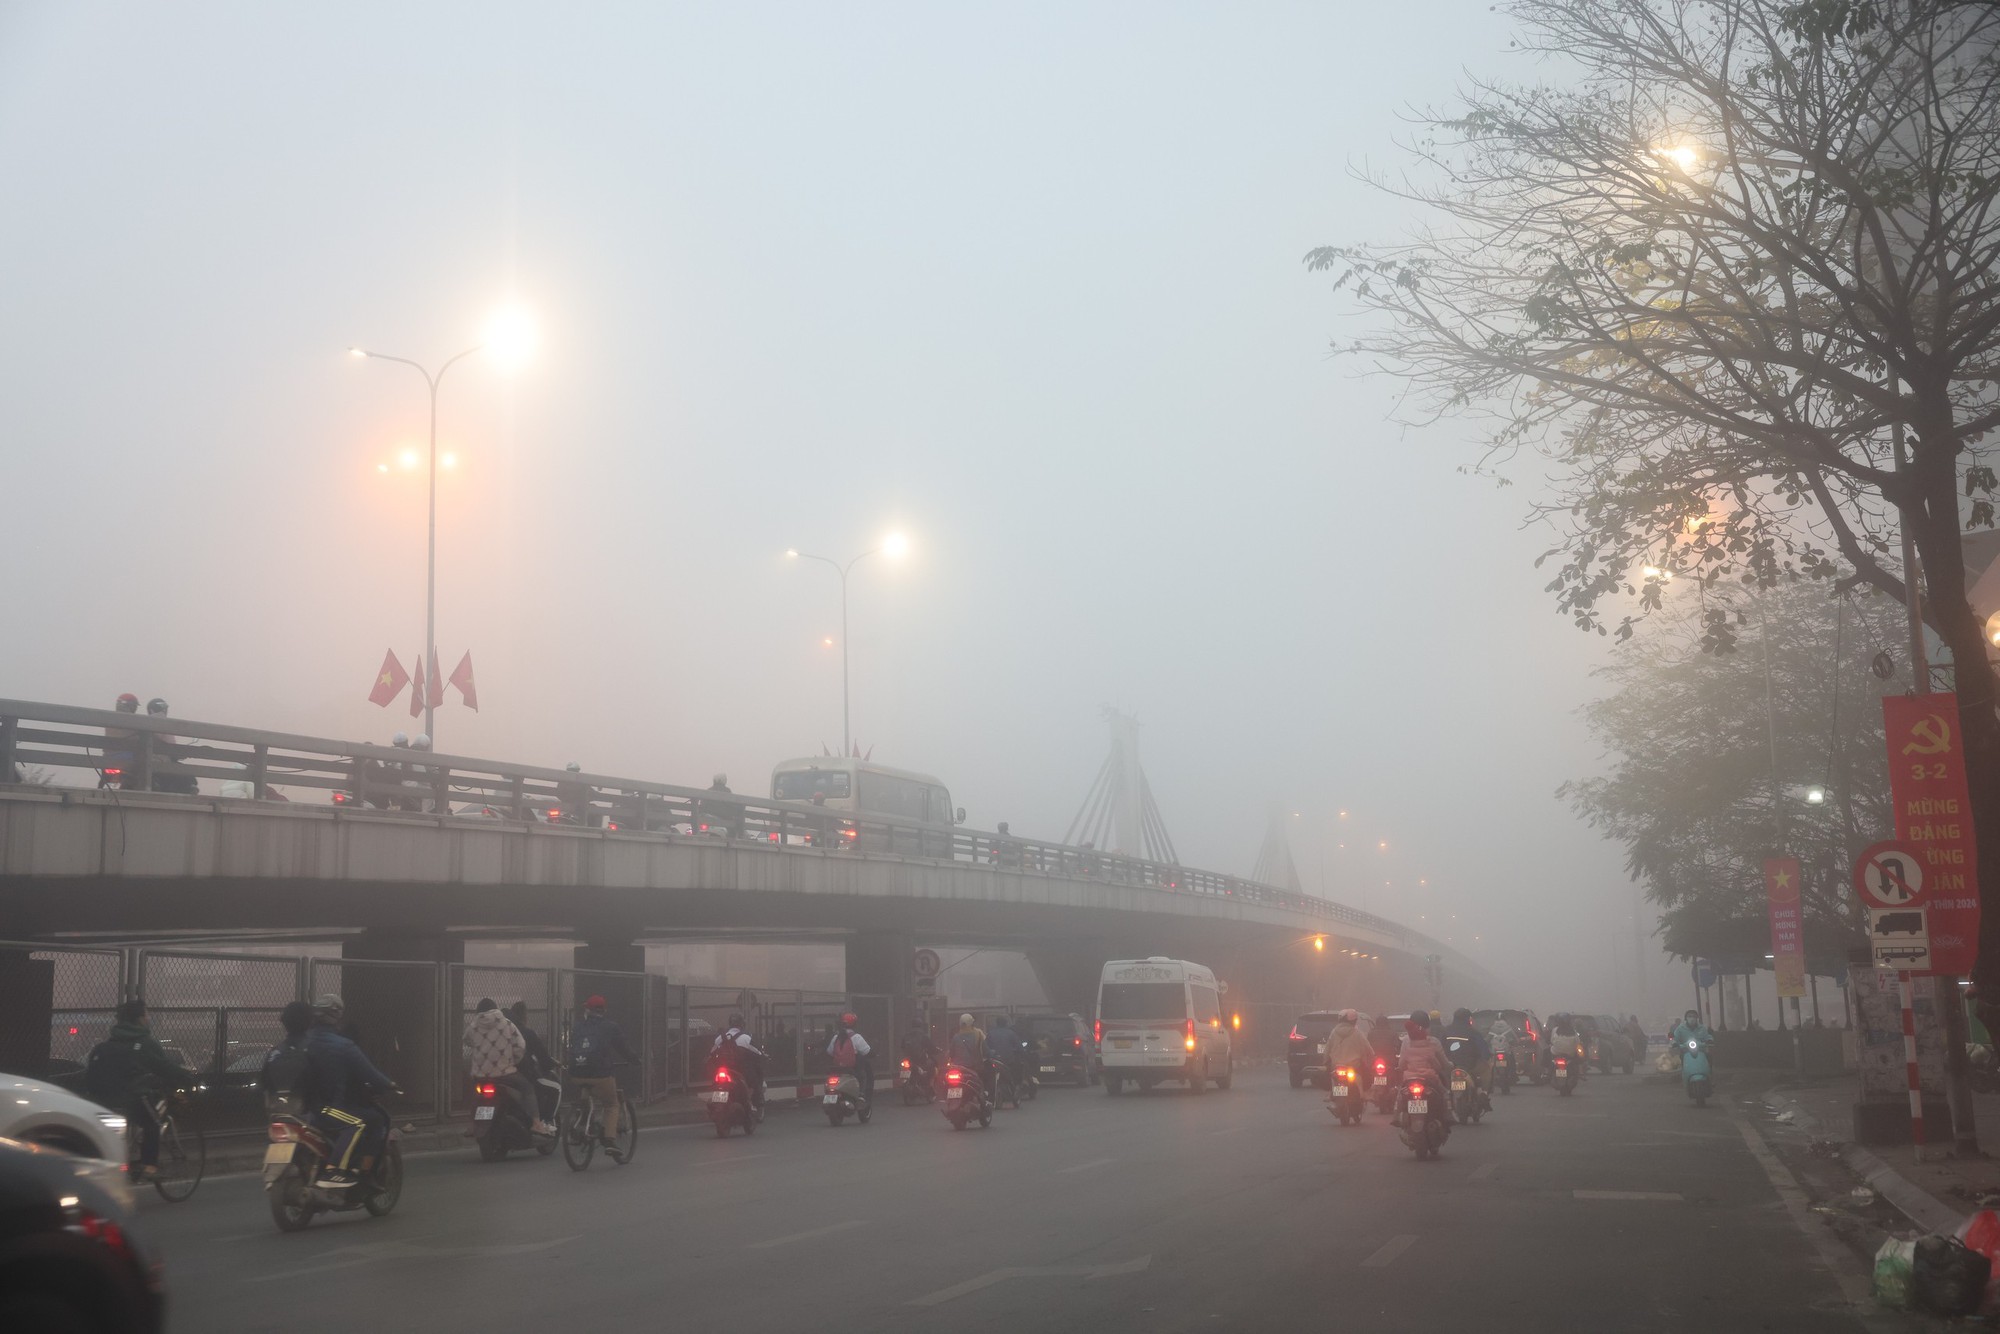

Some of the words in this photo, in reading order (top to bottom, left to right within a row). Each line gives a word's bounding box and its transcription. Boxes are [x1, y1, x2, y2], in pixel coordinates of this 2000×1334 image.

[1911, 763, 1948, 780] 3-2
[1907, 796, 1959, 816] MỪNG
[1909, 820, 1961, 840] ĐẢNG
[1926, 846, 1964, 865] ỪNG
[1955, 898, 1977, 909] 2024
